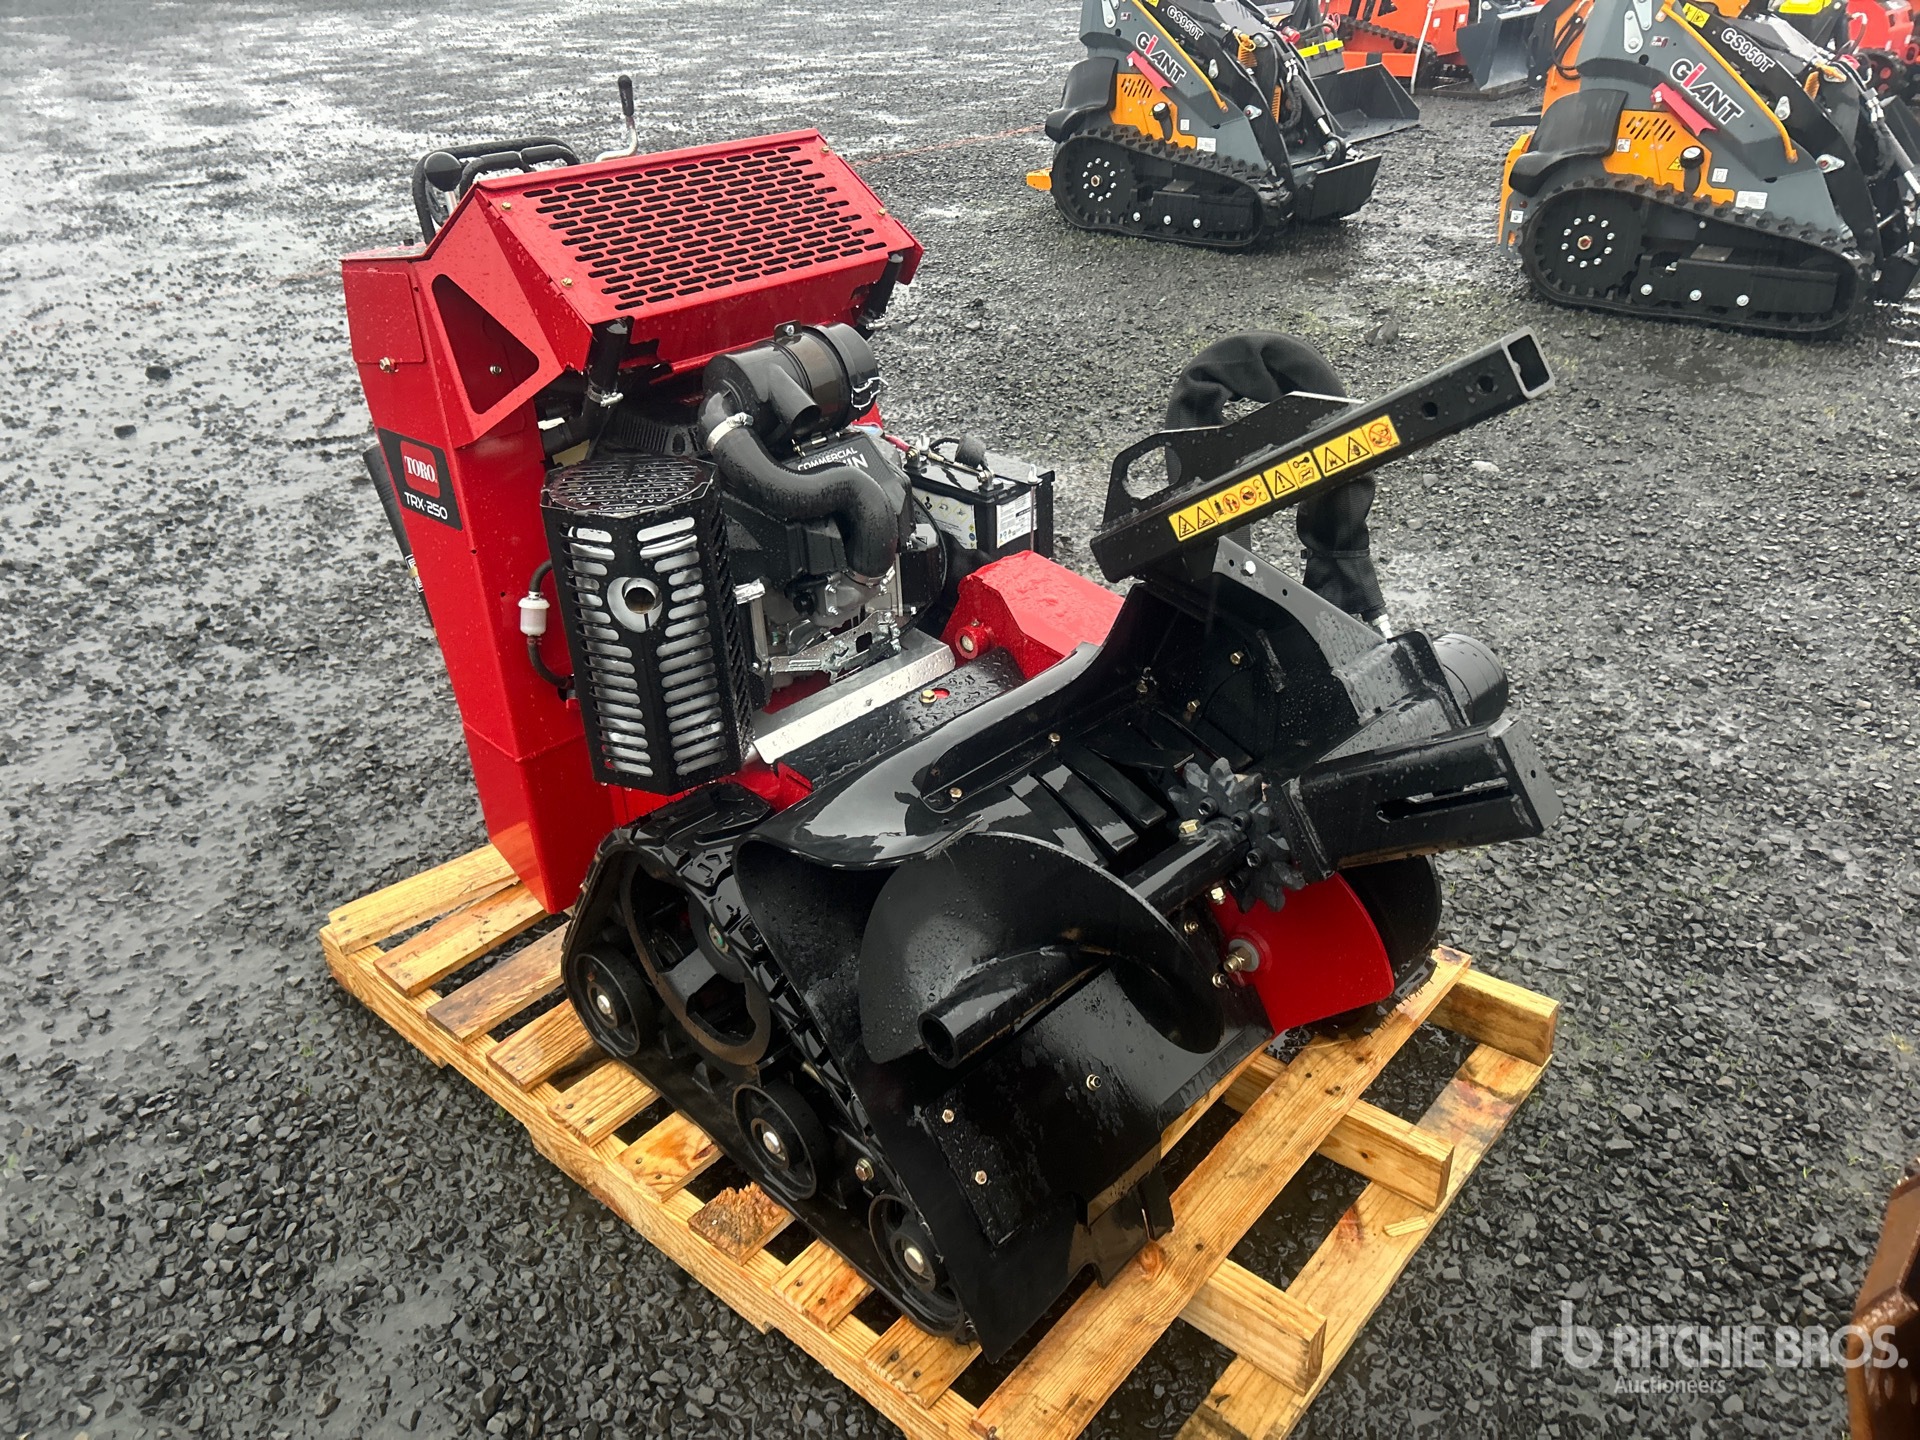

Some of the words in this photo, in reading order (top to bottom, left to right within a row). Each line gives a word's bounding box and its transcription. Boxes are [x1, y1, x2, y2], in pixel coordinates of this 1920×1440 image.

[1167, 5, 1204, 41] GS950T
[1721, 28, 1776, 73] GS950T
[404, 455, 436, 483] TORO
[797, 447, 858, 471] COMMERCIAL
